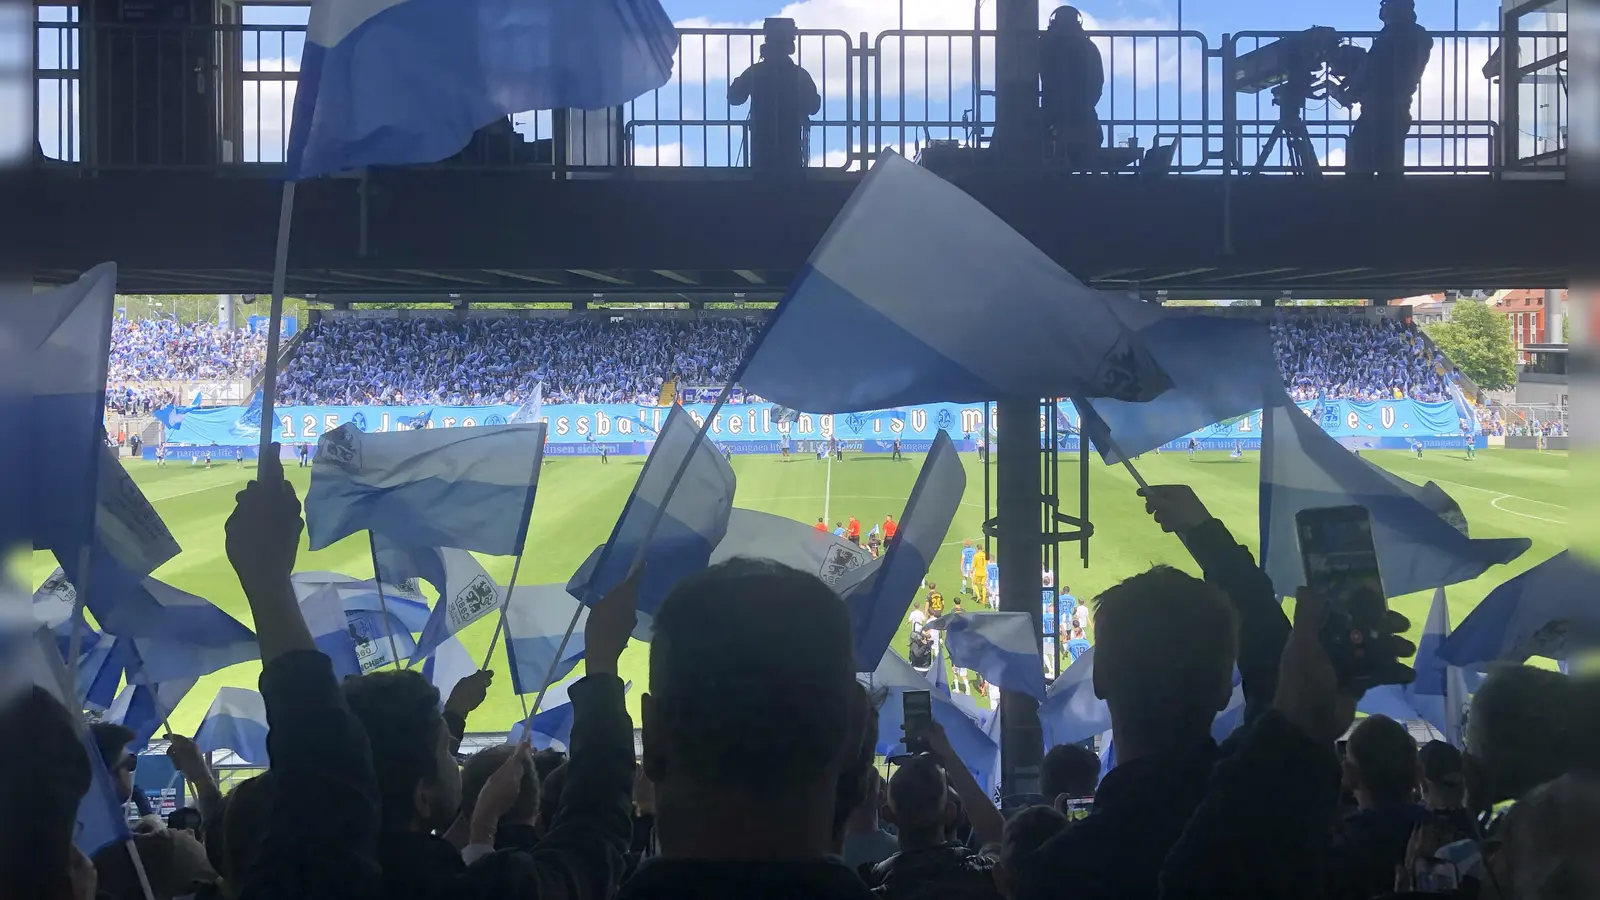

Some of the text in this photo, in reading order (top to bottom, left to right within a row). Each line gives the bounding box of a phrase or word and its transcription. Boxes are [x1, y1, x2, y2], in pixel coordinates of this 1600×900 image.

[281, 414, 340, 438] 125
[545, 444, 576, 453] insen
[1217, 439, 1237, 449] und
